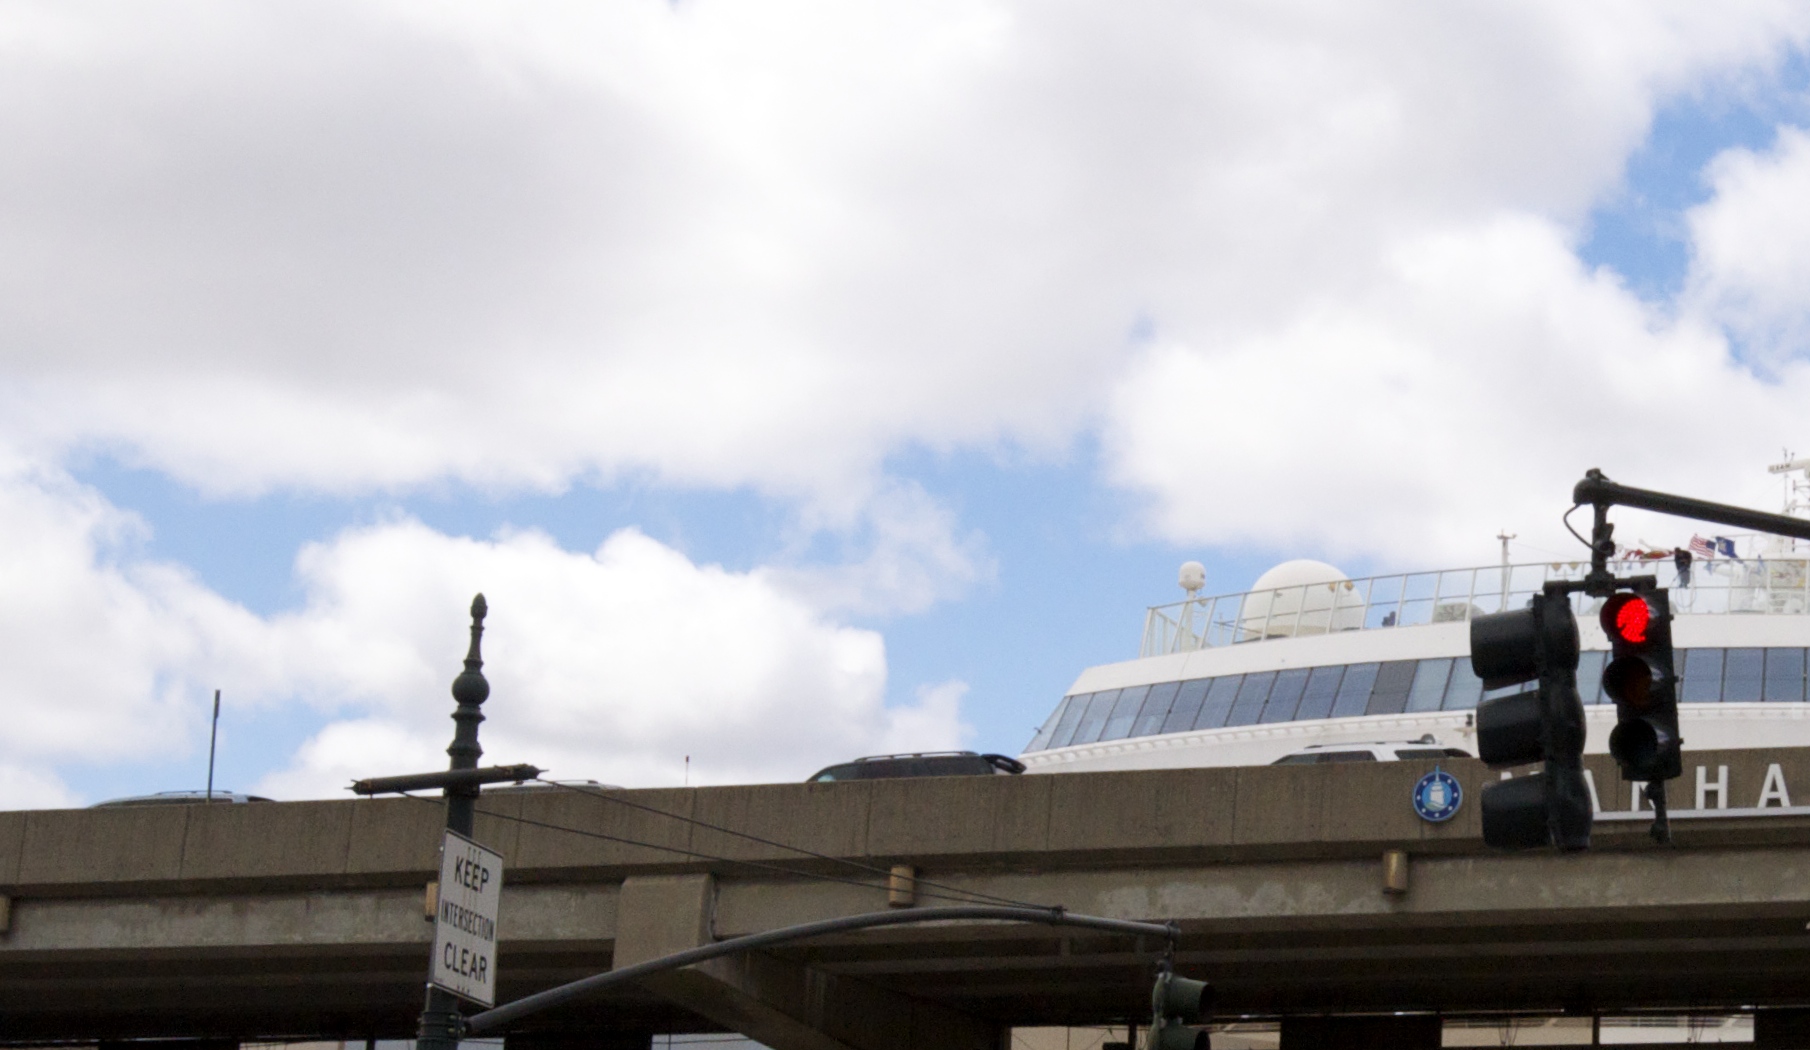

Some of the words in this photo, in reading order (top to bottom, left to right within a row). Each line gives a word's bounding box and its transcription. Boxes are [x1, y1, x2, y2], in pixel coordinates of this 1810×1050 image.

[454, 856, 490, 894] KEEP
[441, 900, 495, 942] INTERSECTION
[444, 942, 488, 984] CLEAR
